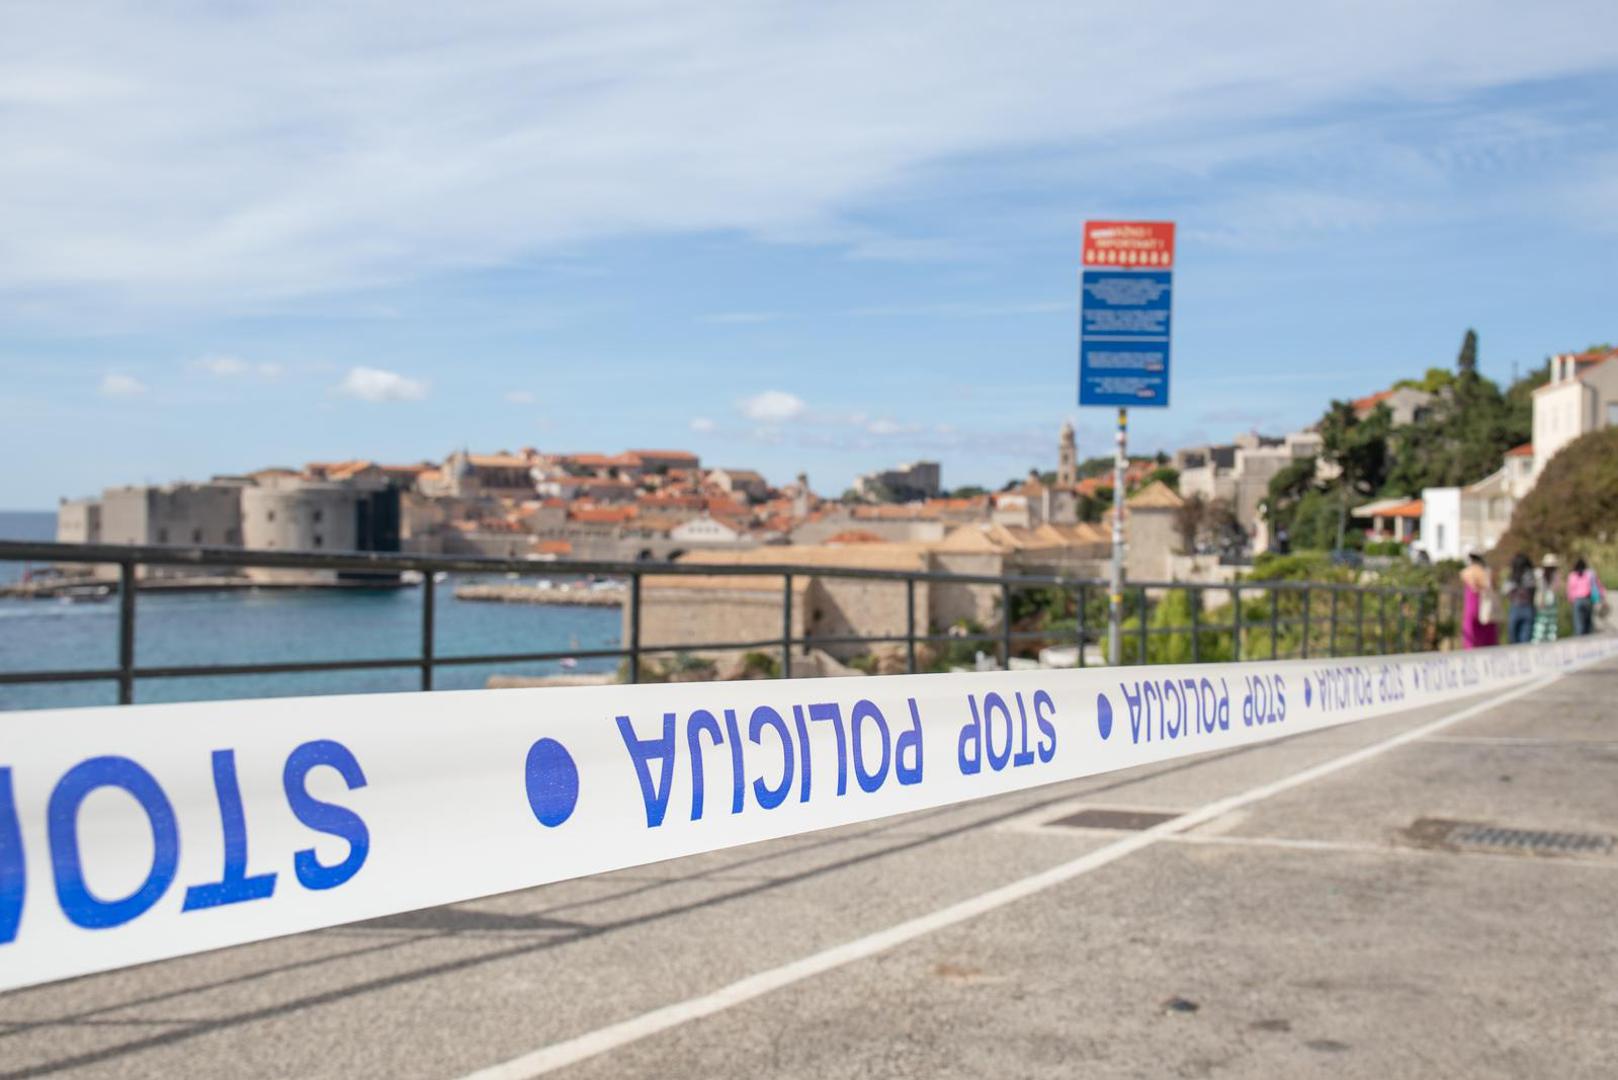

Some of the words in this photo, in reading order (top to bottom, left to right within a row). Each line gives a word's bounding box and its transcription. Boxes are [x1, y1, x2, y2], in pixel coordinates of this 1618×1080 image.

[957, 689, 1057, 776] STOP
[1119, 677, 1231, 745] POLICIJA
[1243, 674, 1287, 727] STOP
[615, 699, 924, 829] POLICIJA
[0, 739, 370, 945] STO
